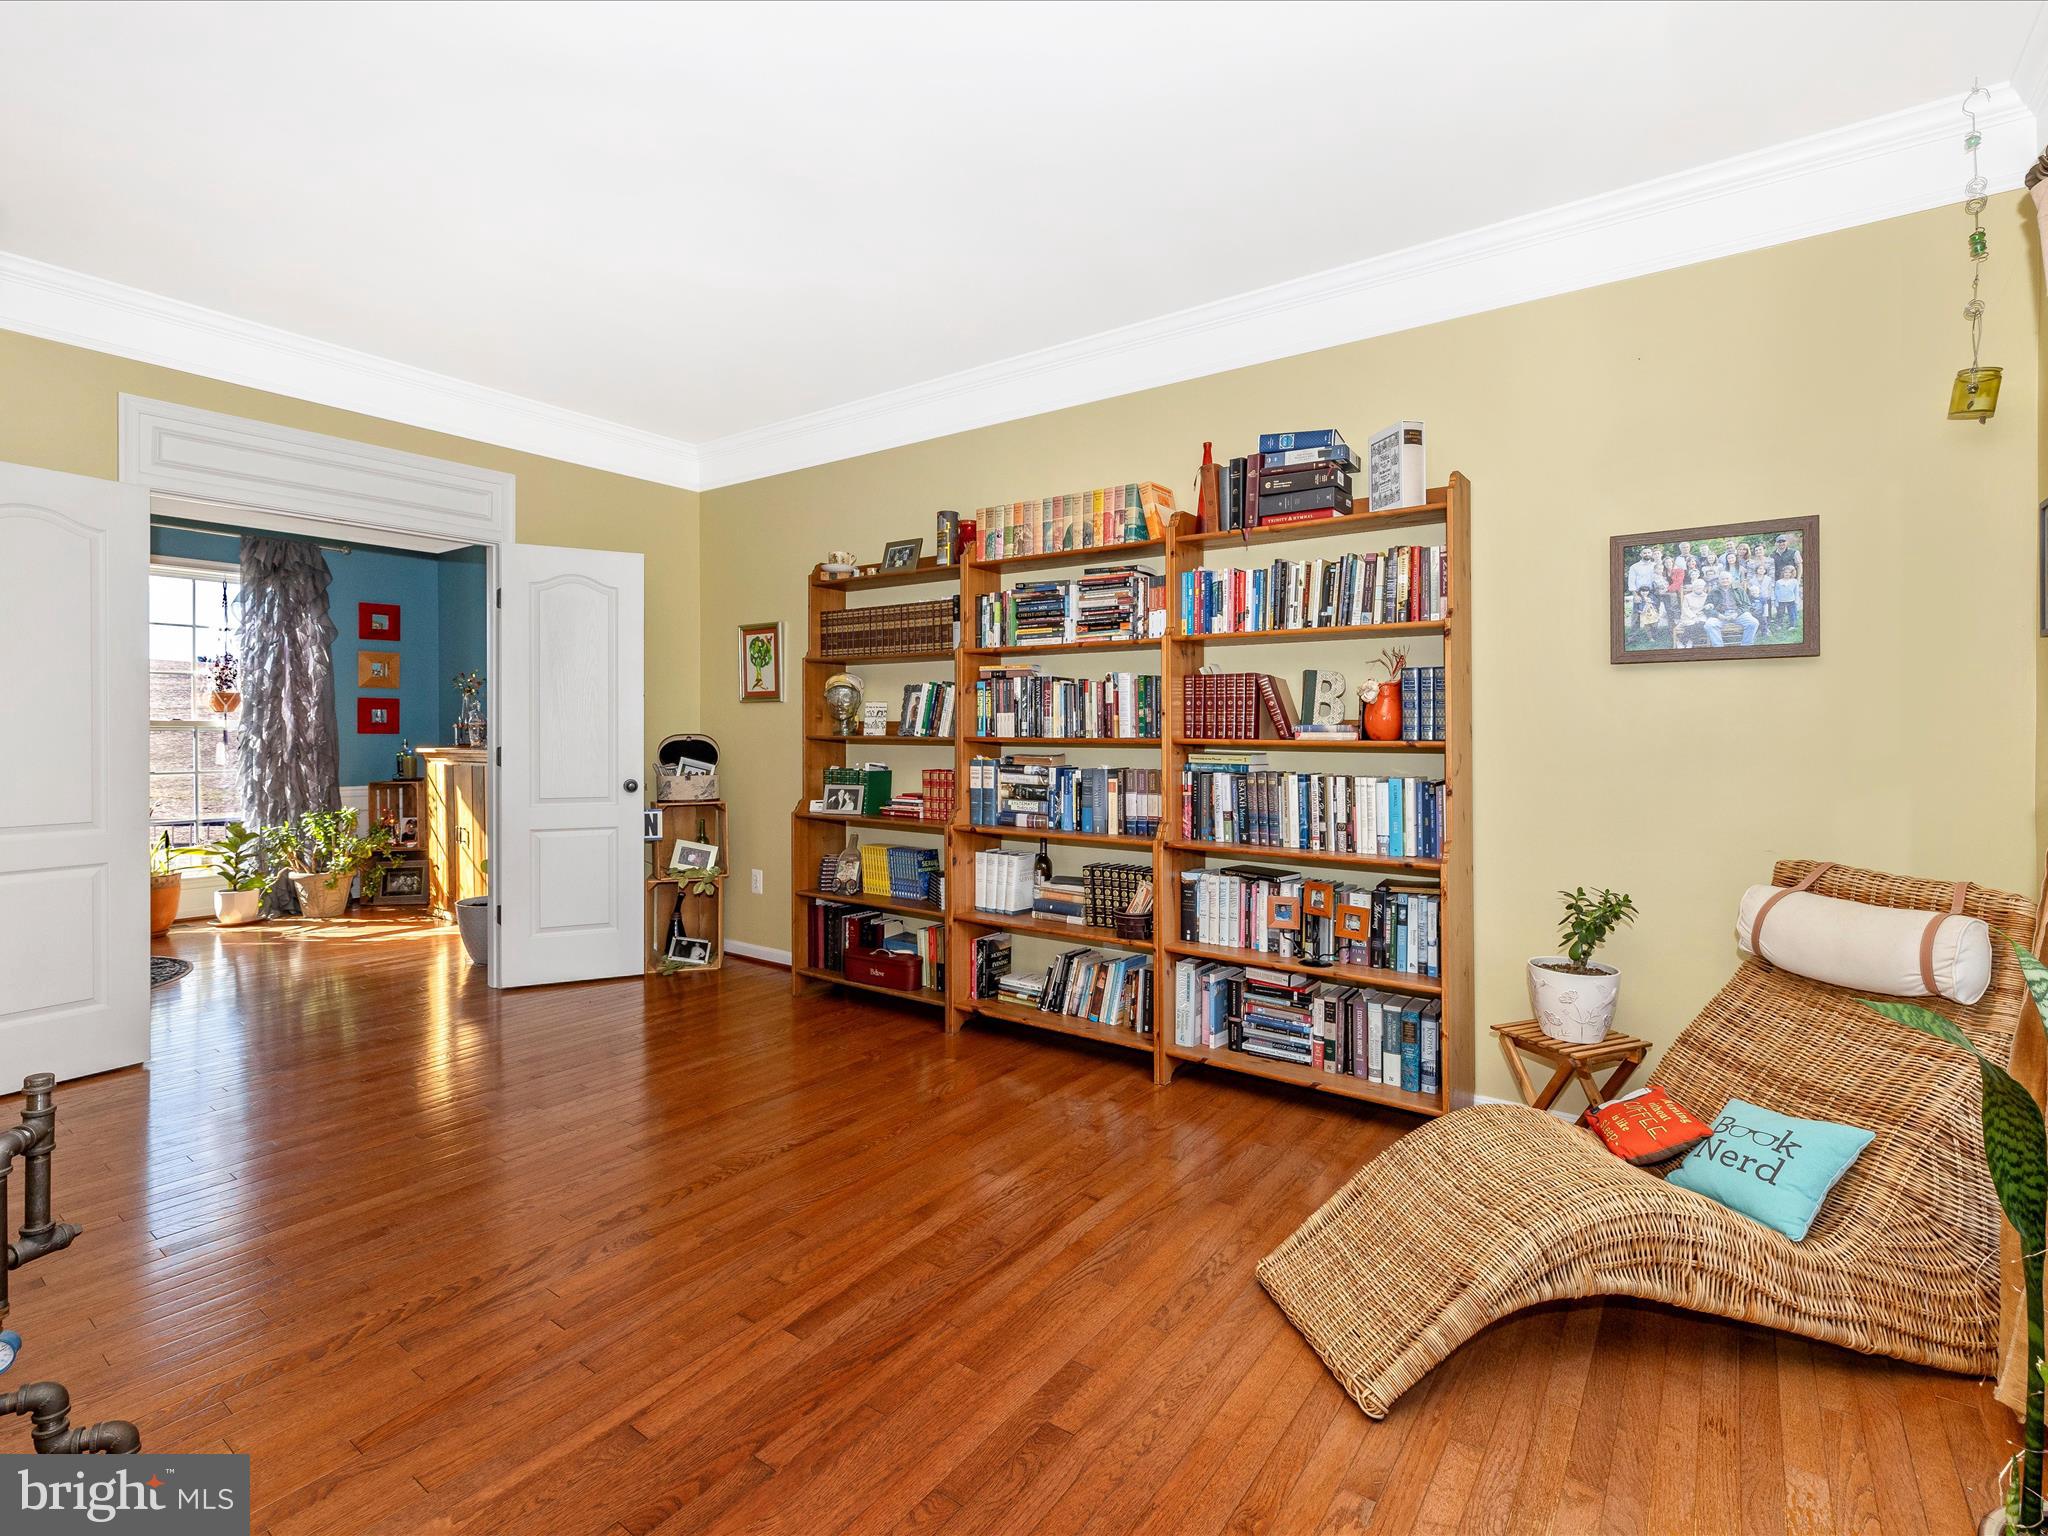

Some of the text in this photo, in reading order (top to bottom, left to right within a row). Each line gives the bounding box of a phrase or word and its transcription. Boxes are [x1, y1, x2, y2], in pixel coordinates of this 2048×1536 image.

[1312, 670, 1346, 726] B
[644, 813, 658, 836] N
[1616, 1117, 1630, 1132] like
[1624, 1101, 1667, 1140] COFFEE
[1714, 1116, 1802, 1159] Book
[1693, 1138, 1786, 1186] Nerd
